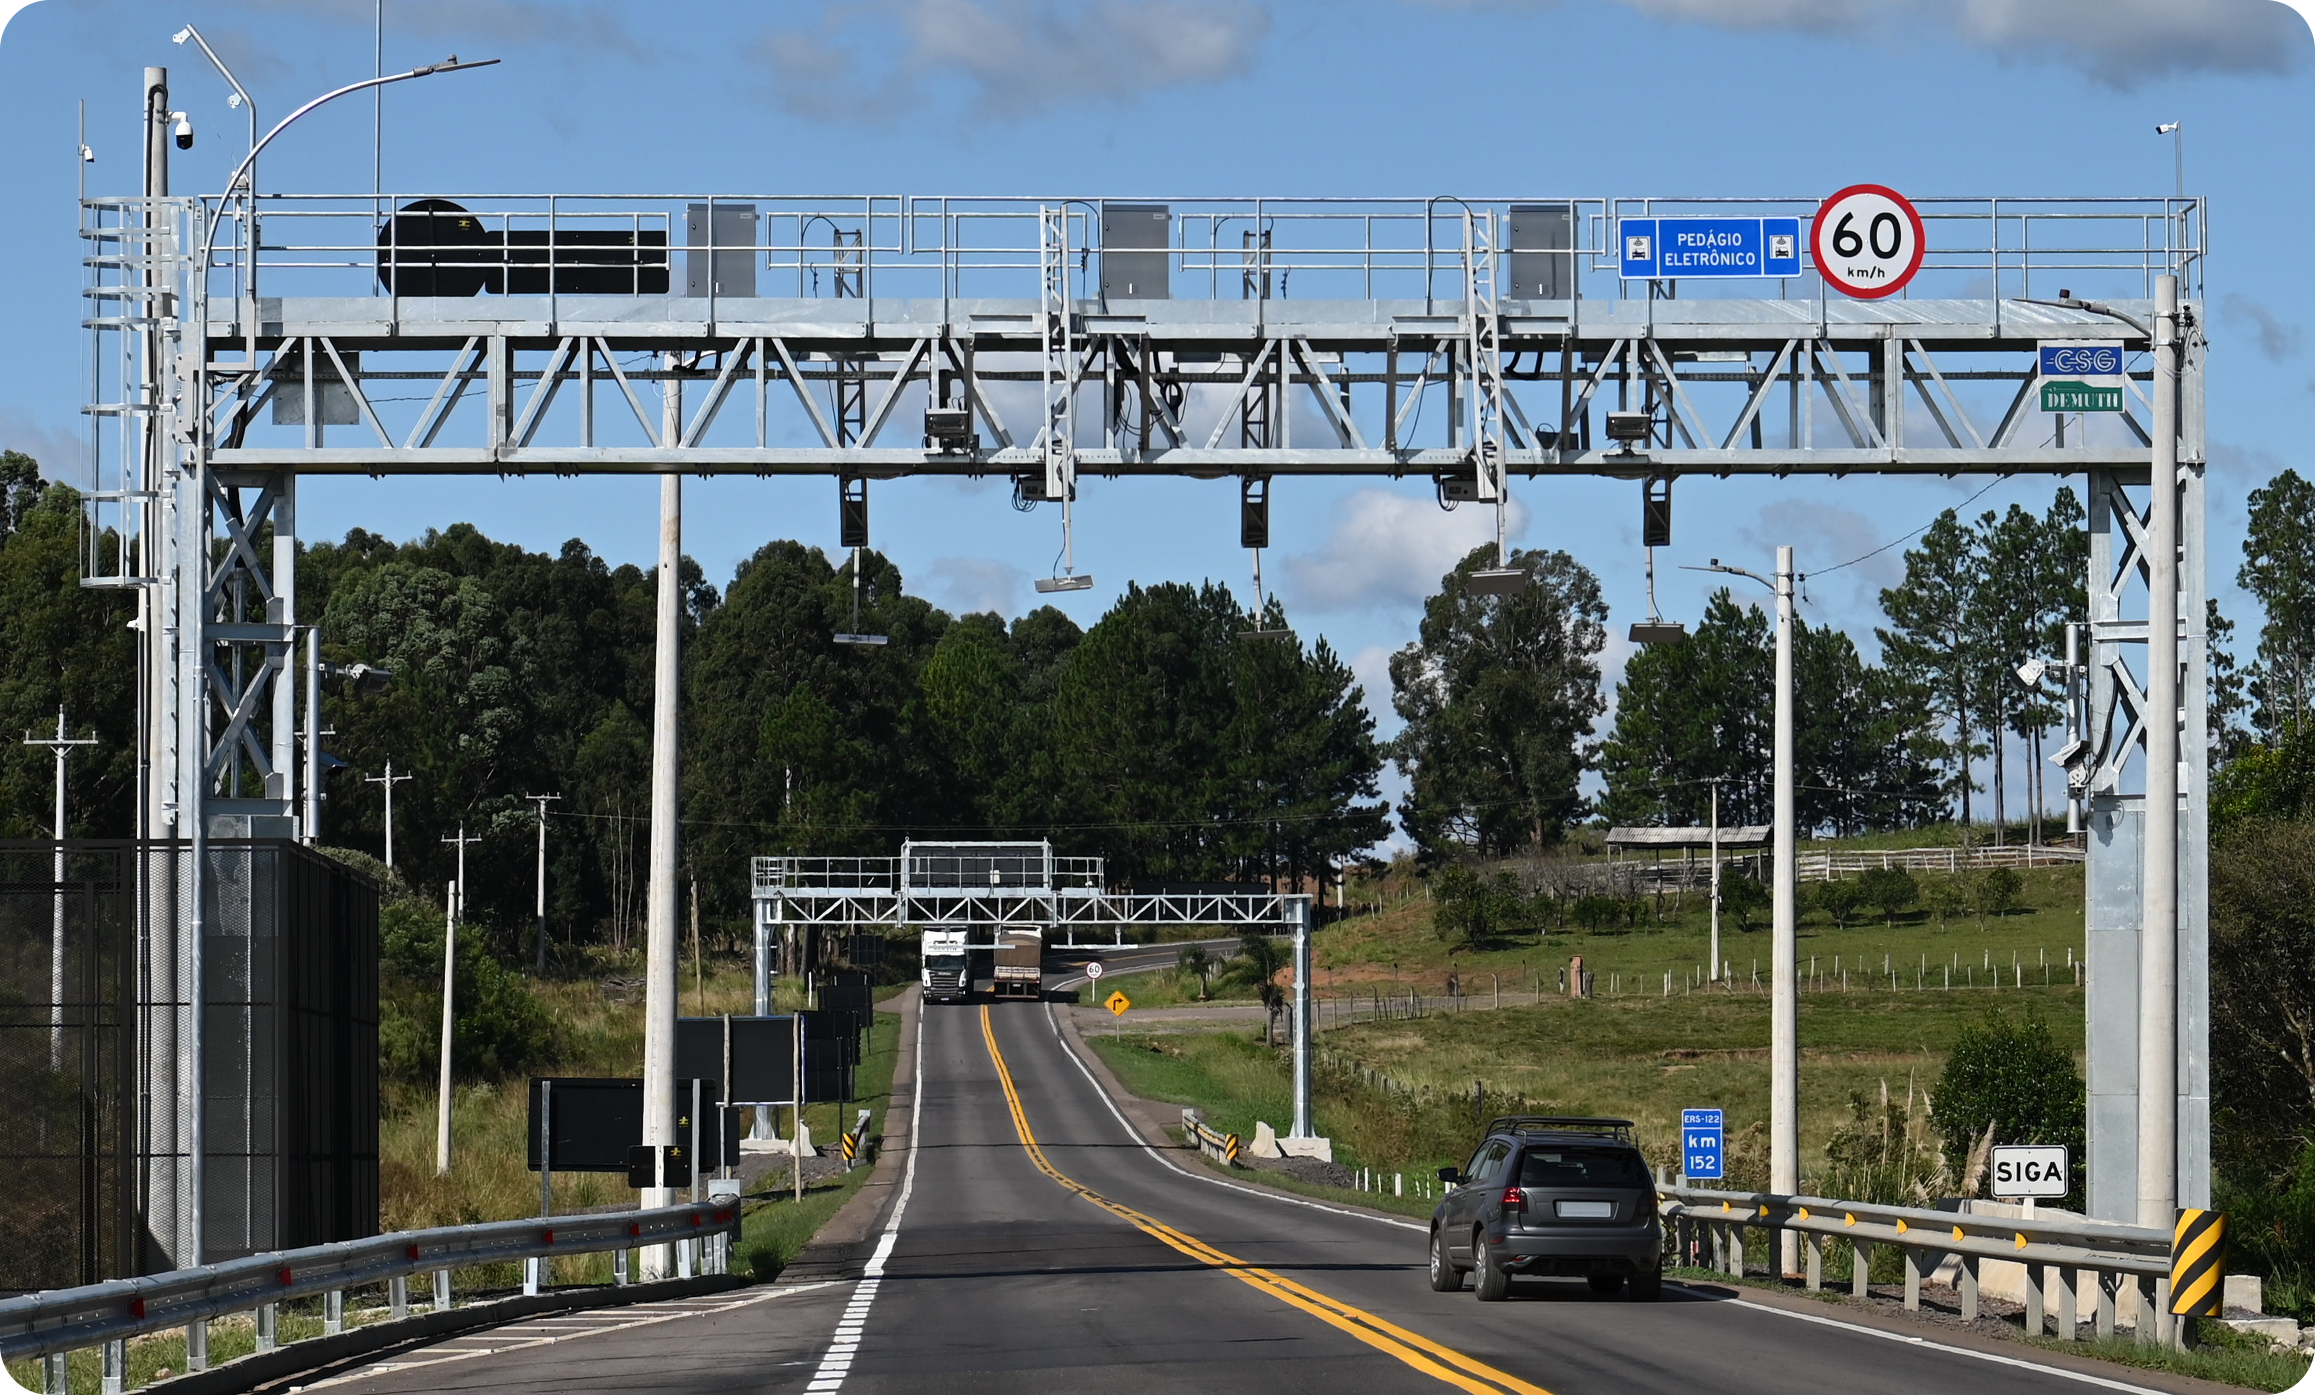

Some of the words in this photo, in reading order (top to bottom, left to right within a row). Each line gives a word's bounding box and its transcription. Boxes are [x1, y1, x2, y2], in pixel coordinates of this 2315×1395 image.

[1677, 229, 1742, 247] PEDÁGIO
[1832, 211, 1902, 260] 60
[1664, 248, 1756, 266] ELETRÔNICO
[1847, 265, 1886, 279] km/h
[2054, 349, 2117, 373] CSG
[2047, 392, 2119, 408] DEMUTH
[1089, 965, 1100, 973] 60
[1684, 1115, 1720, 1124] ERS-122
[1688, 1134, 1716, 1148] km
[1690, 1155, 1716, 1170] 152
[1996, 1161, 2063, 1183] SIGA
